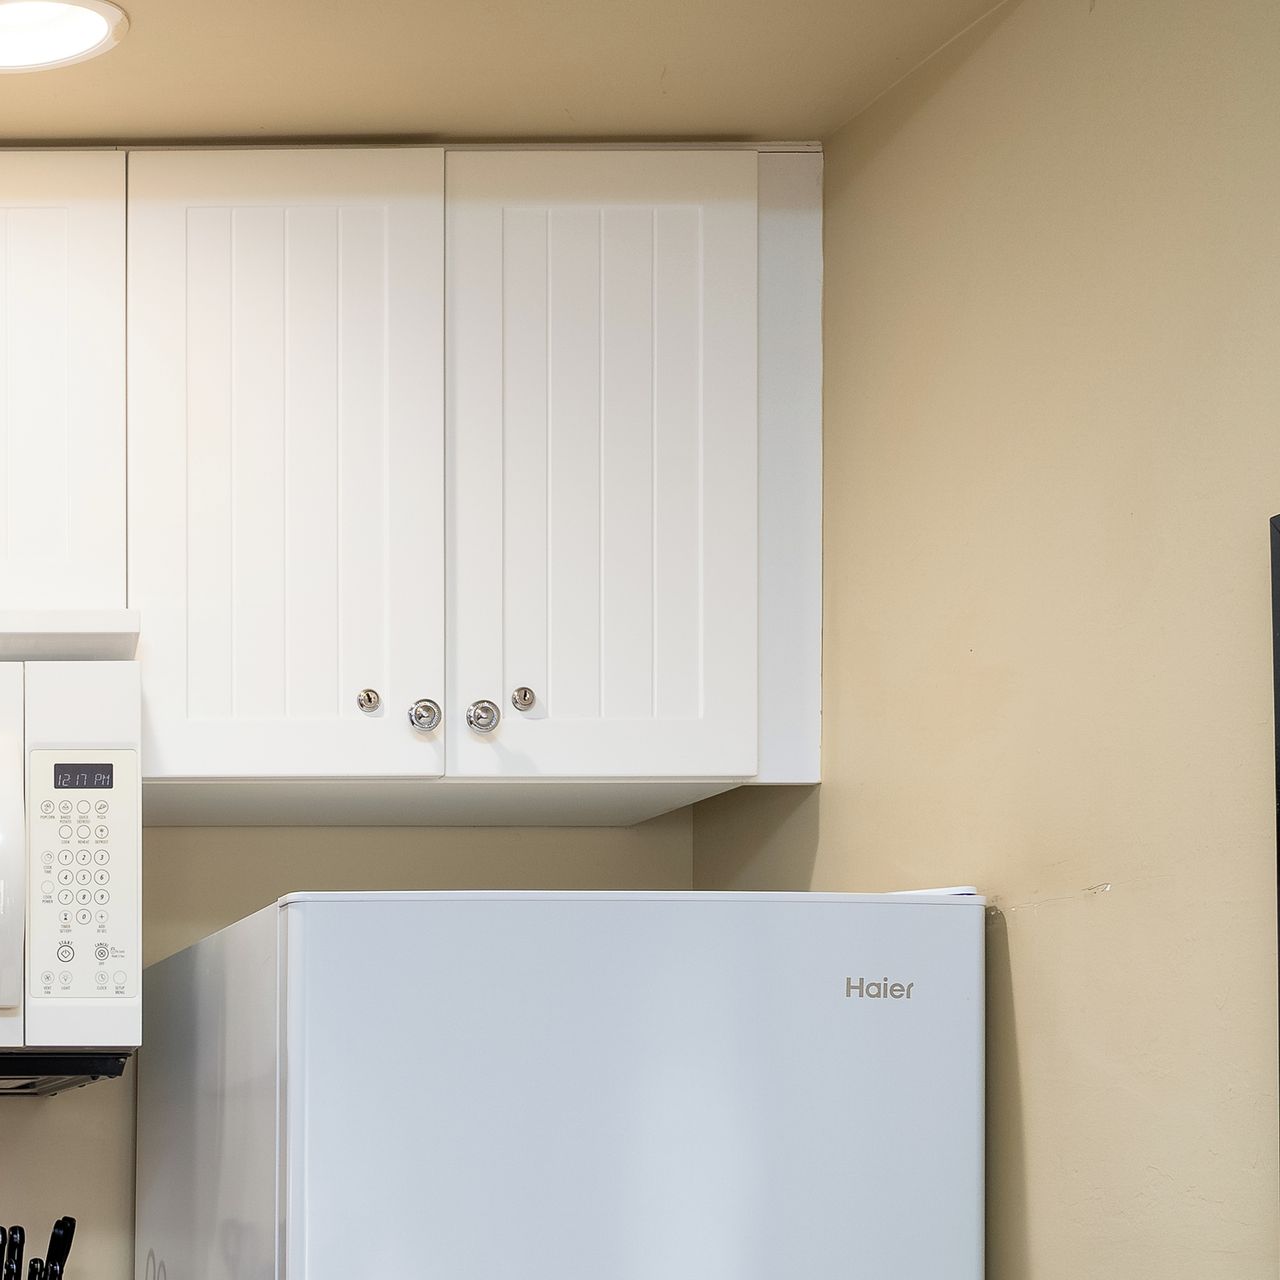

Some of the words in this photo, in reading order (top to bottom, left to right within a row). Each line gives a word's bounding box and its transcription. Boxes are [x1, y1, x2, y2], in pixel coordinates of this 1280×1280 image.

[94, 773, 110, 786] PM
[99, 893, 105, 901] 9
[844, 976, 915, 999] Haier
